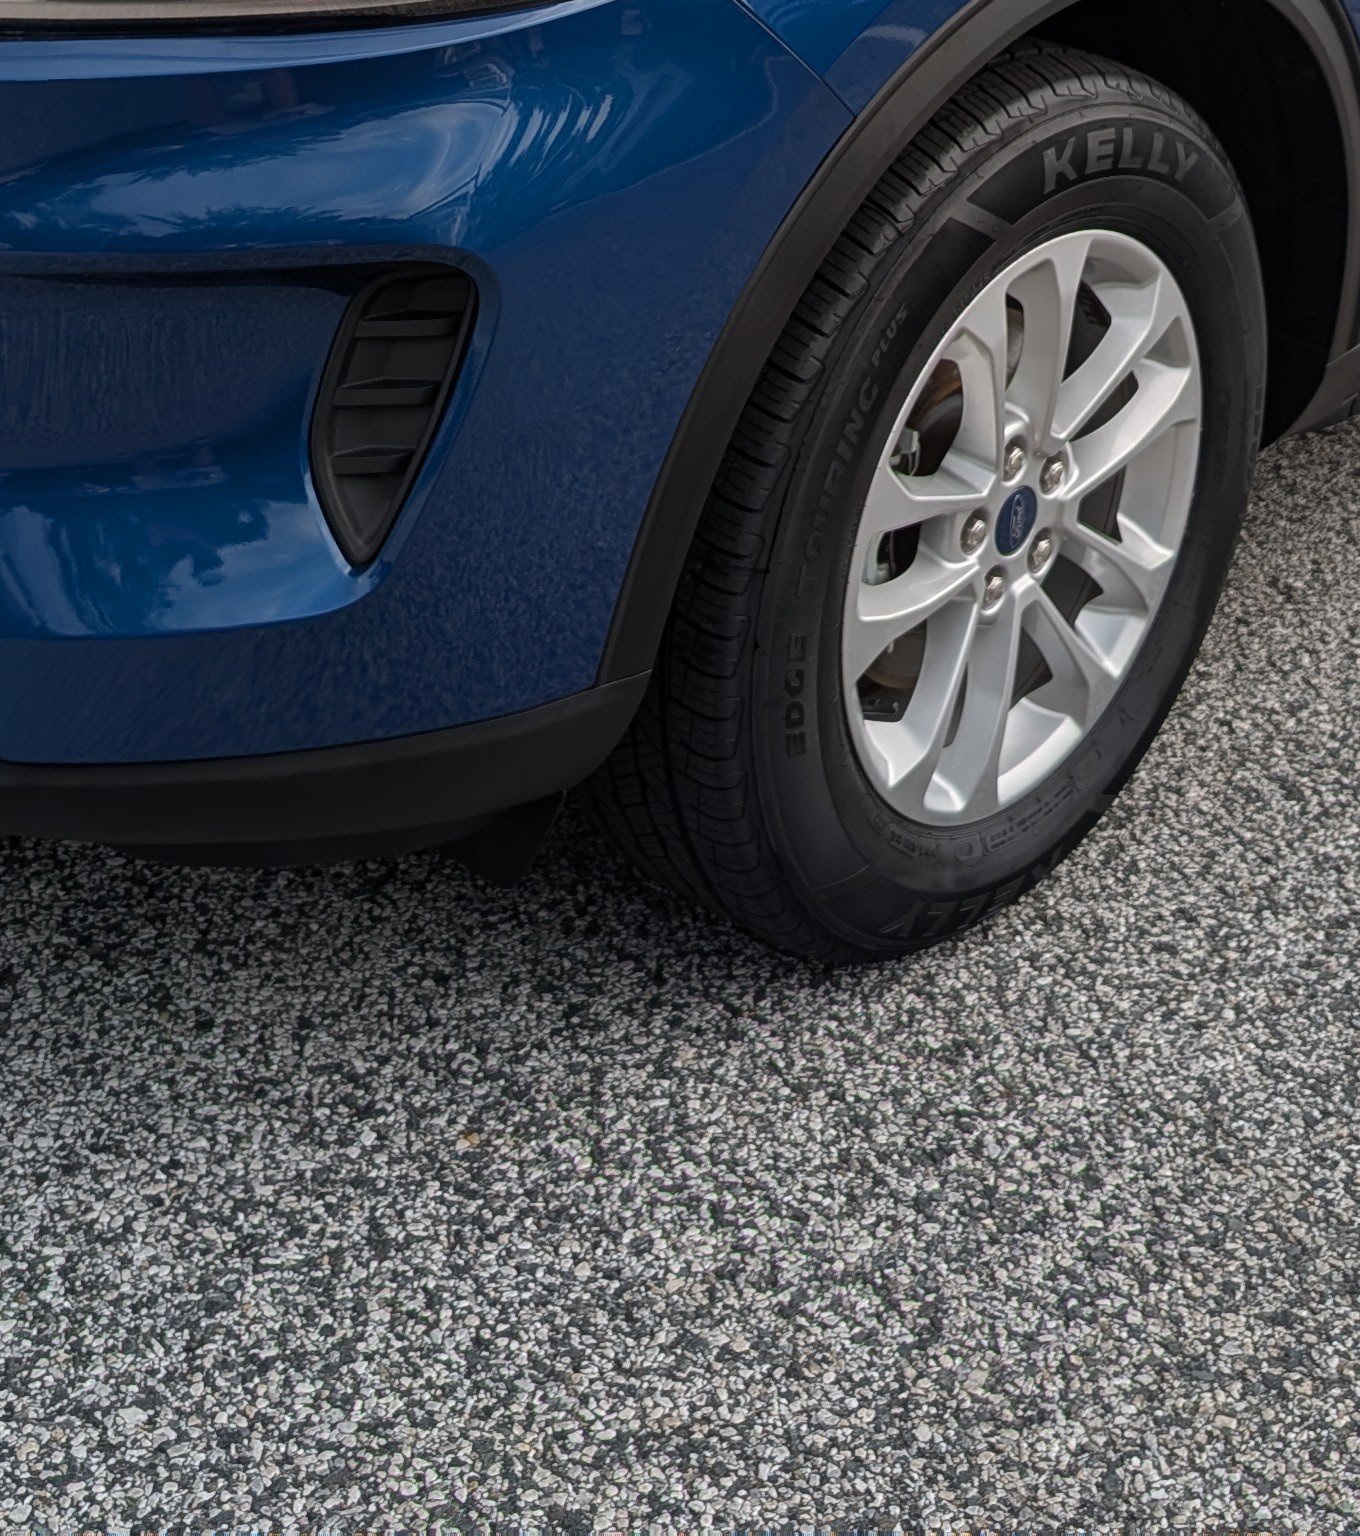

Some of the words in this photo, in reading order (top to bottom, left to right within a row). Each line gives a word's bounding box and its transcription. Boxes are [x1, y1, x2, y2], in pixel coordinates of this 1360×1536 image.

[1042, 126, 1198, 195] KELLY
[783, 631, 809, 758] EDGE
[870, 302, 909, 368] PLUS
